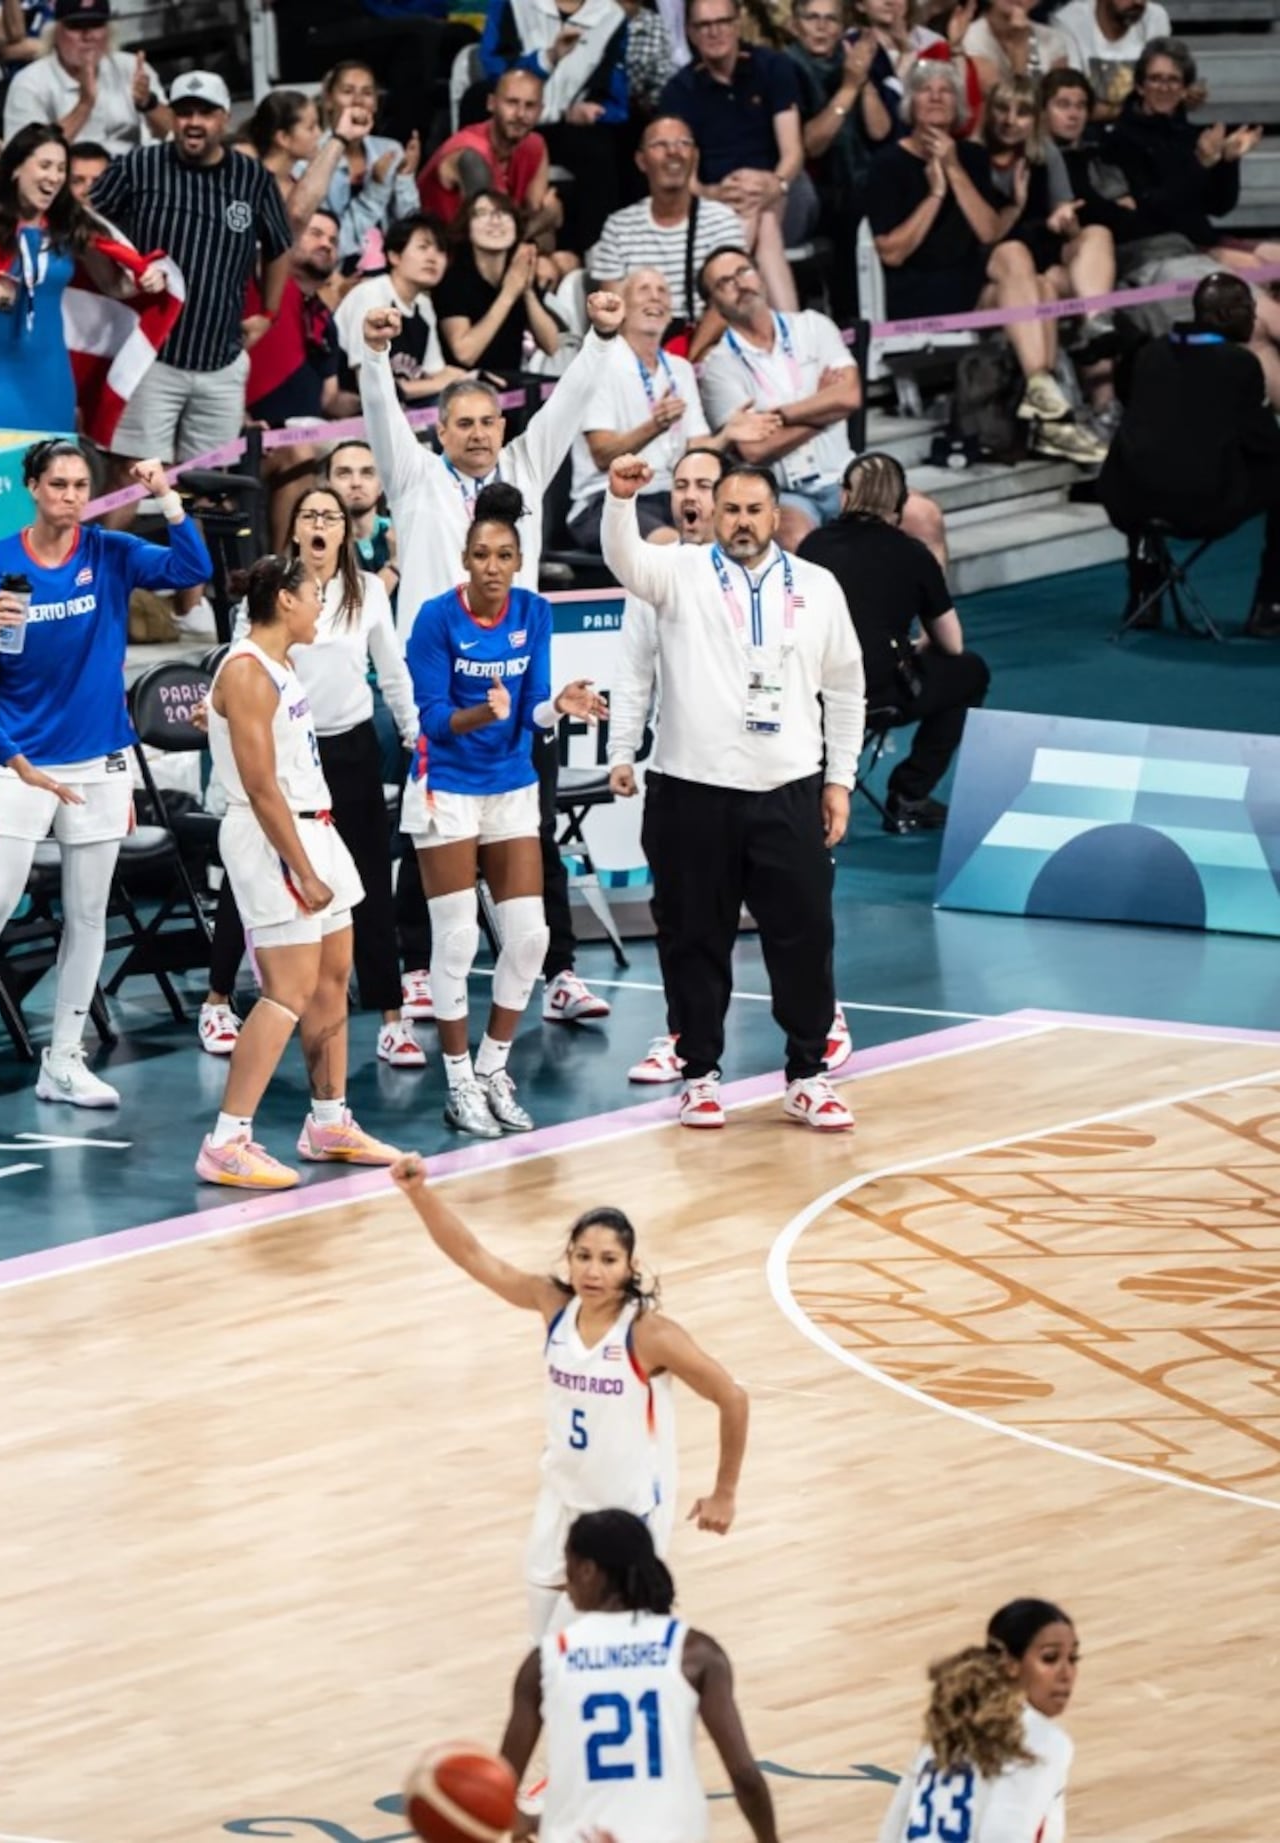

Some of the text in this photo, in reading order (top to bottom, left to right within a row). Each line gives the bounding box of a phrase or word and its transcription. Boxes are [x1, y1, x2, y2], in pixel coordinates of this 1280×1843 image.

[583, 613, 622, 629] PARI
[455, 658, 505, 678] PUERTO
[589, 1377, 624, 1396] RICO
[569, 1408, 589, 1451] 5
[582, 1689, 663, 1782] 21
